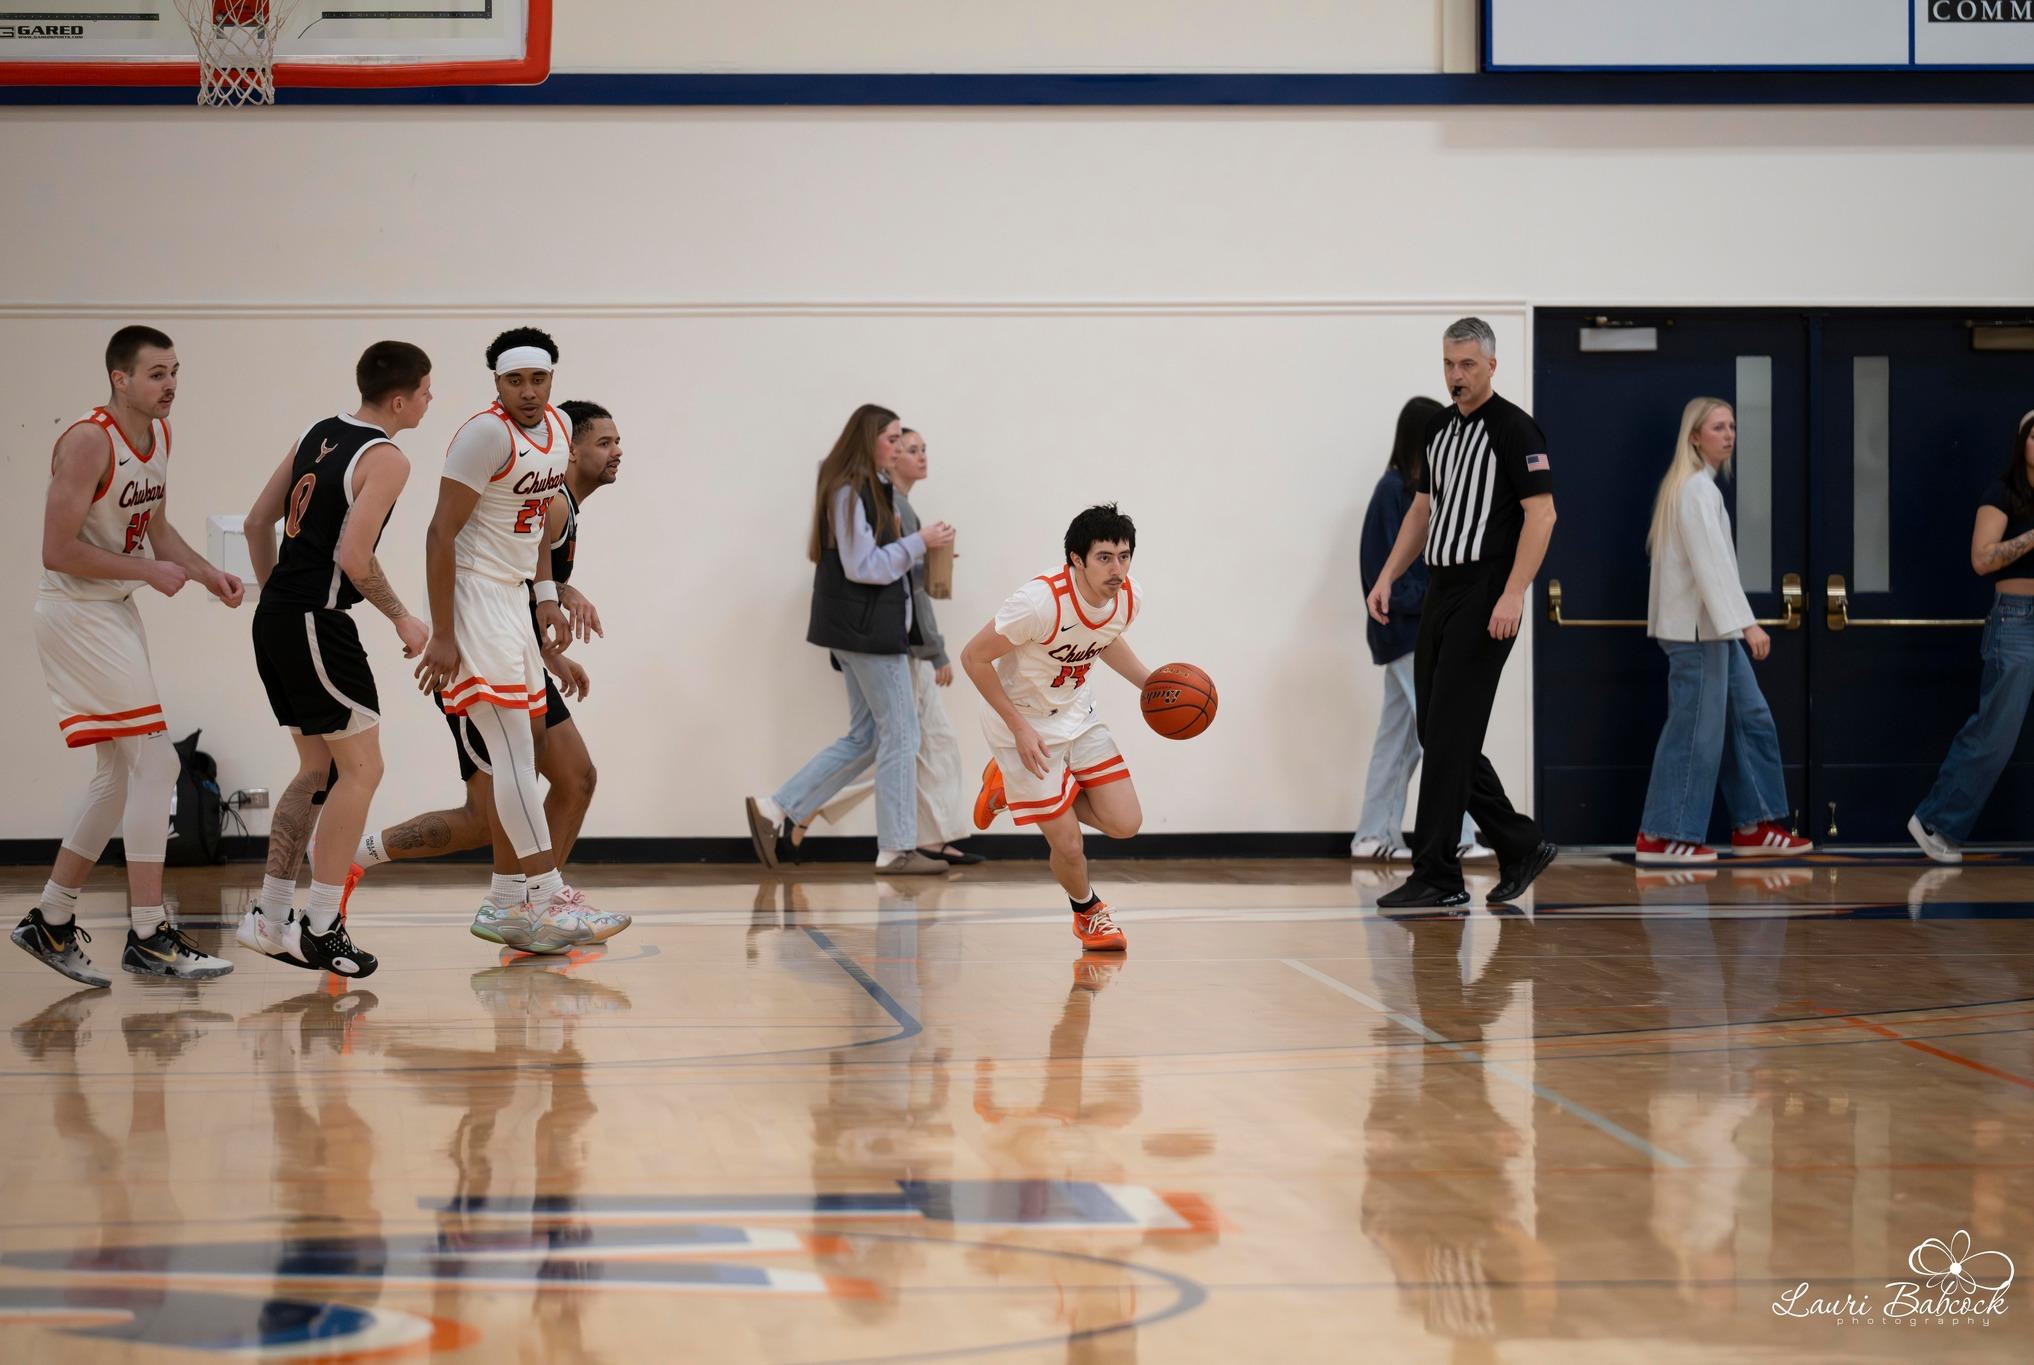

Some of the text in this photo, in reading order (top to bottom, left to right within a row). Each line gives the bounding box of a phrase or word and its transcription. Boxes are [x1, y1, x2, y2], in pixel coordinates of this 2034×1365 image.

[1932, 0, 2033, 20] COMM
[17, 25, 84, 36] GARED
[511, 467, 564, 495] Chukar
[285, 473, 317, 538] 0
